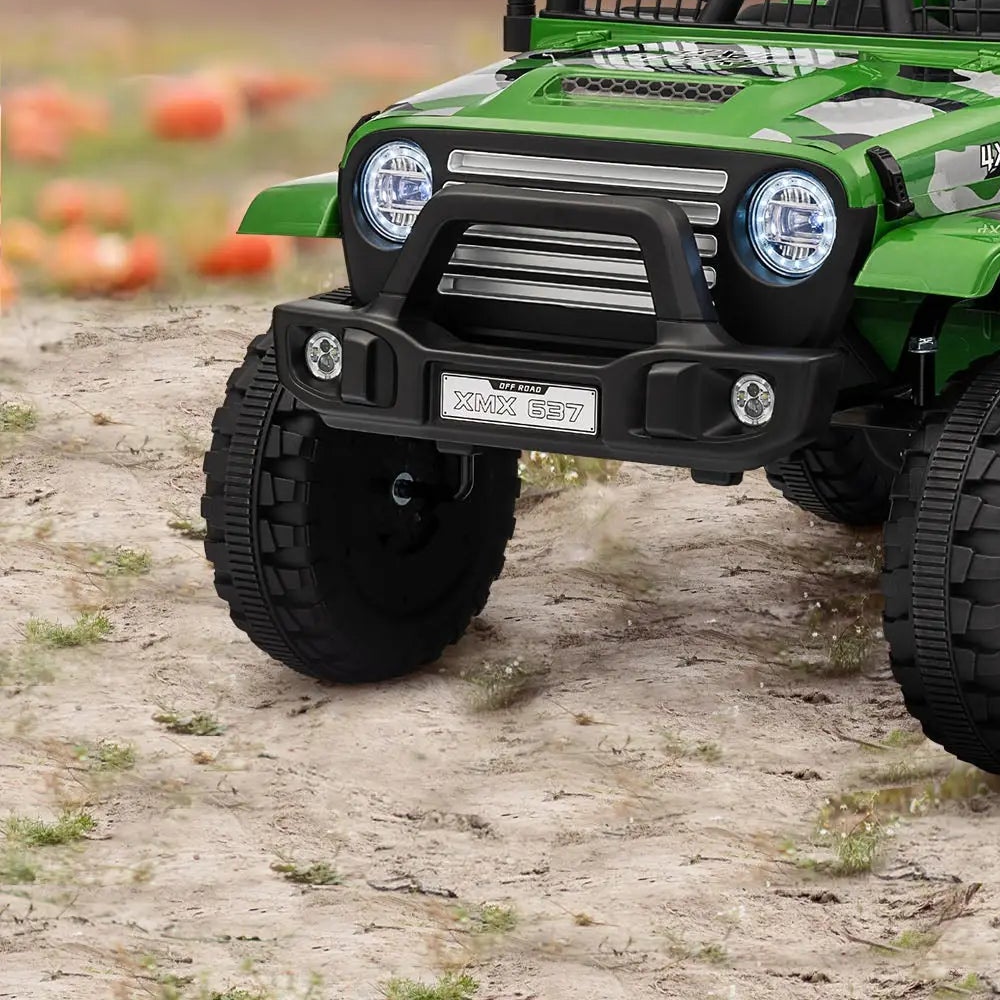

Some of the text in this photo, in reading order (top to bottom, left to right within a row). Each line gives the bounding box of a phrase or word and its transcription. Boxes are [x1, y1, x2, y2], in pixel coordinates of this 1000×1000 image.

[499, 382, 542, 393] OFF ROAD
[454, 390, 585, 423] XMX 637
